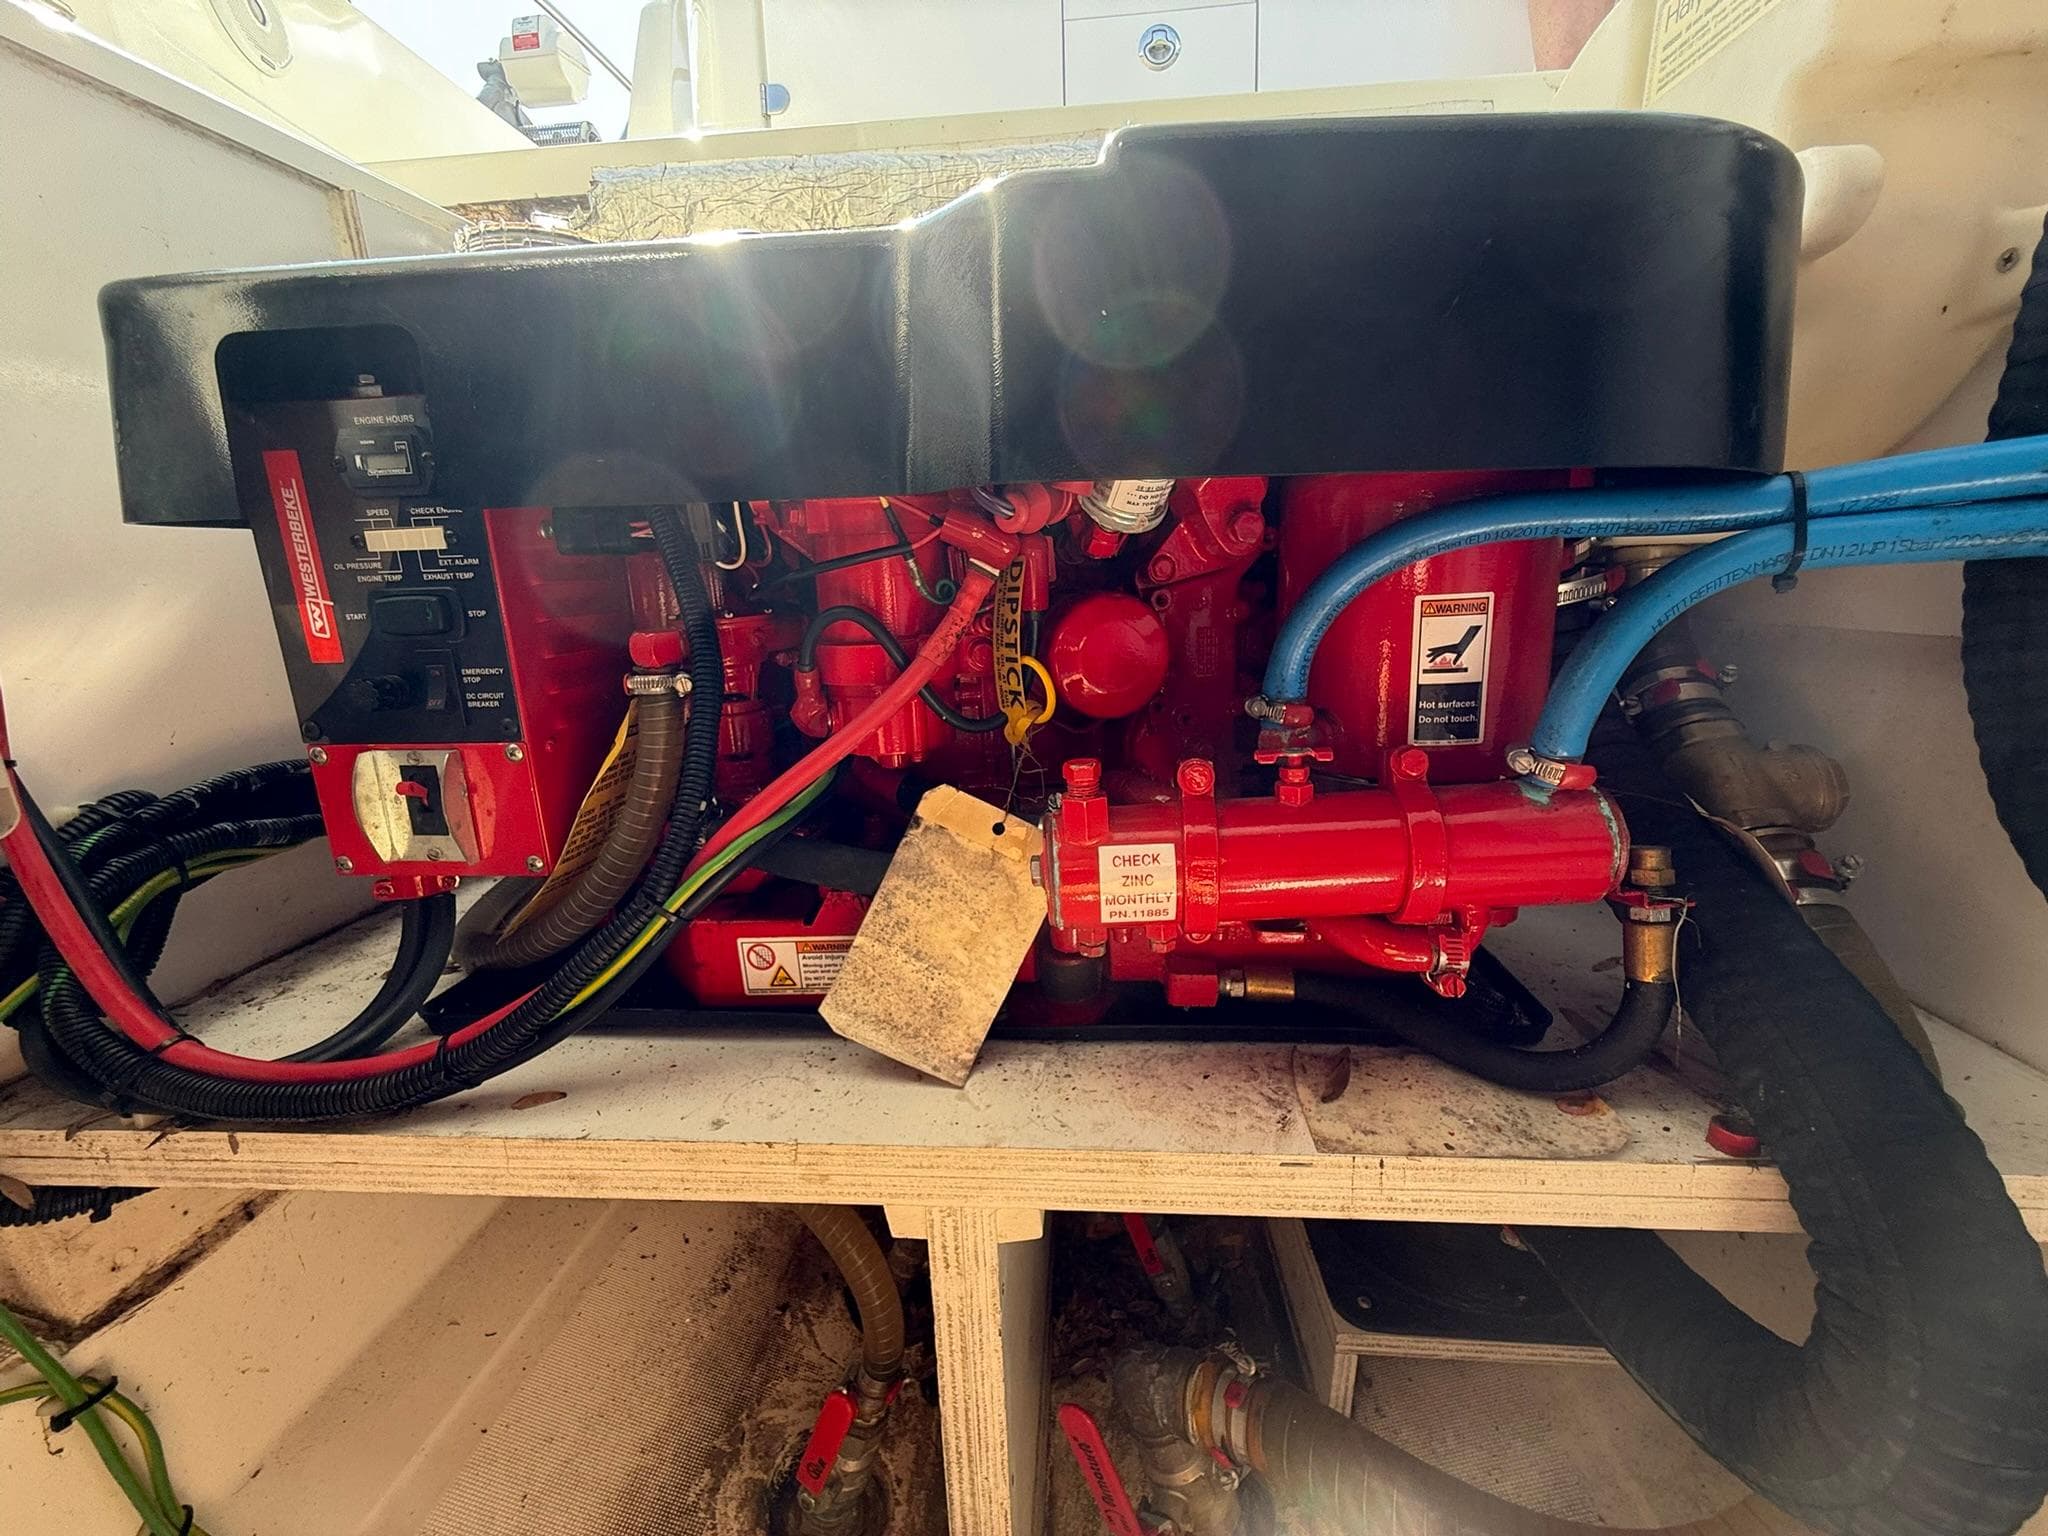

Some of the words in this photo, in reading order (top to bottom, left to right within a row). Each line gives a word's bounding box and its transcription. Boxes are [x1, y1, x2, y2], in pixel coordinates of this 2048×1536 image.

[354, 416, 385, 425] ENGINE
[386, 414, 415, 423] HOURS
[366, 508, 390, 516] SPEED
[410, 506, 436, 515] CHECK
[281, 486, 319, 599] WESTERBEKE
[347, 561, 383, 570] PRESSURE
[357, 575, 383, 583] ENGINE
[384, 574, 403, 582] TEMP
[423, 573, 455, 581] EXHAUST
[455, 572, 475, 580] TEMP
[1436, 602, 1487, 614] WARNING
[345, 613, 367, 621] START
[468, 610, 487, 618] STOP
[1004, 559, 1025, 710] DIPSTICK
[461, 668, 504, 676] EMERGENCY
[477, 692, 505, 700] CIRCUIT
[1419, 701, 1436, 710] Hot
[1438, 699, 1478, 709] surfaces.
[1418, 715, 1432, 724] Do
[1433, 714, 1449, 724] not
[1450, 713, 1478, 723] touch.
[1112, 853, 1161, 868] CHECK
[1121, 874, 1155, 887] ZINC
[1105, 892, 1174, 906] MONTHLY
[1109, 908, 1170, 919] PN.11885
